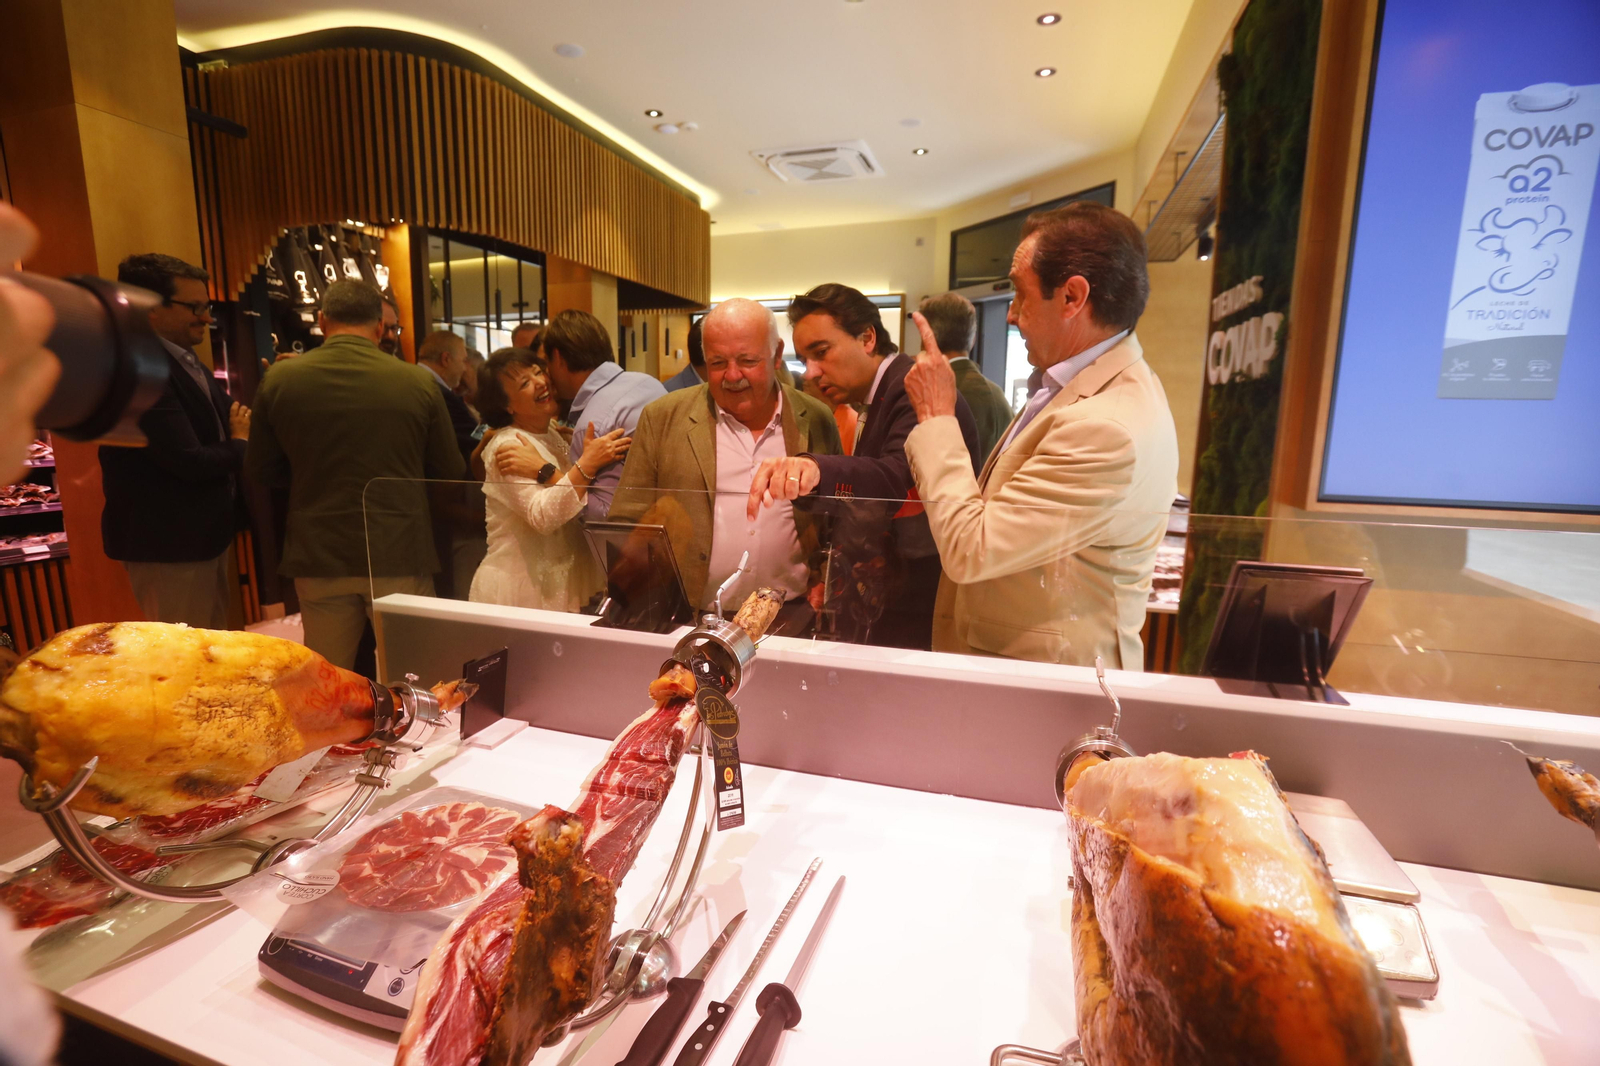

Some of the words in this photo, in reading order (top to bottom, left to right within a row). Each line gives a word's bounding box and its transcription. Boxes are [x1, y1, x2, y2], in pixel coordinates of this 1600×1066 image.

[1484, 122, 1594, 152] COVAP
[1508, 166, 1552, 193] a2
[1505, 194, 1550, 206] protein
[1212, 275, 1264, 322] TIENDAS
[1466, 306, 1551, 321] TRADICIÓN
[1207, 311, 1284, 385] COVAP
[282, 883, 327, 895] CUCHILLO
[290, 891, 315, 899] CORTE
